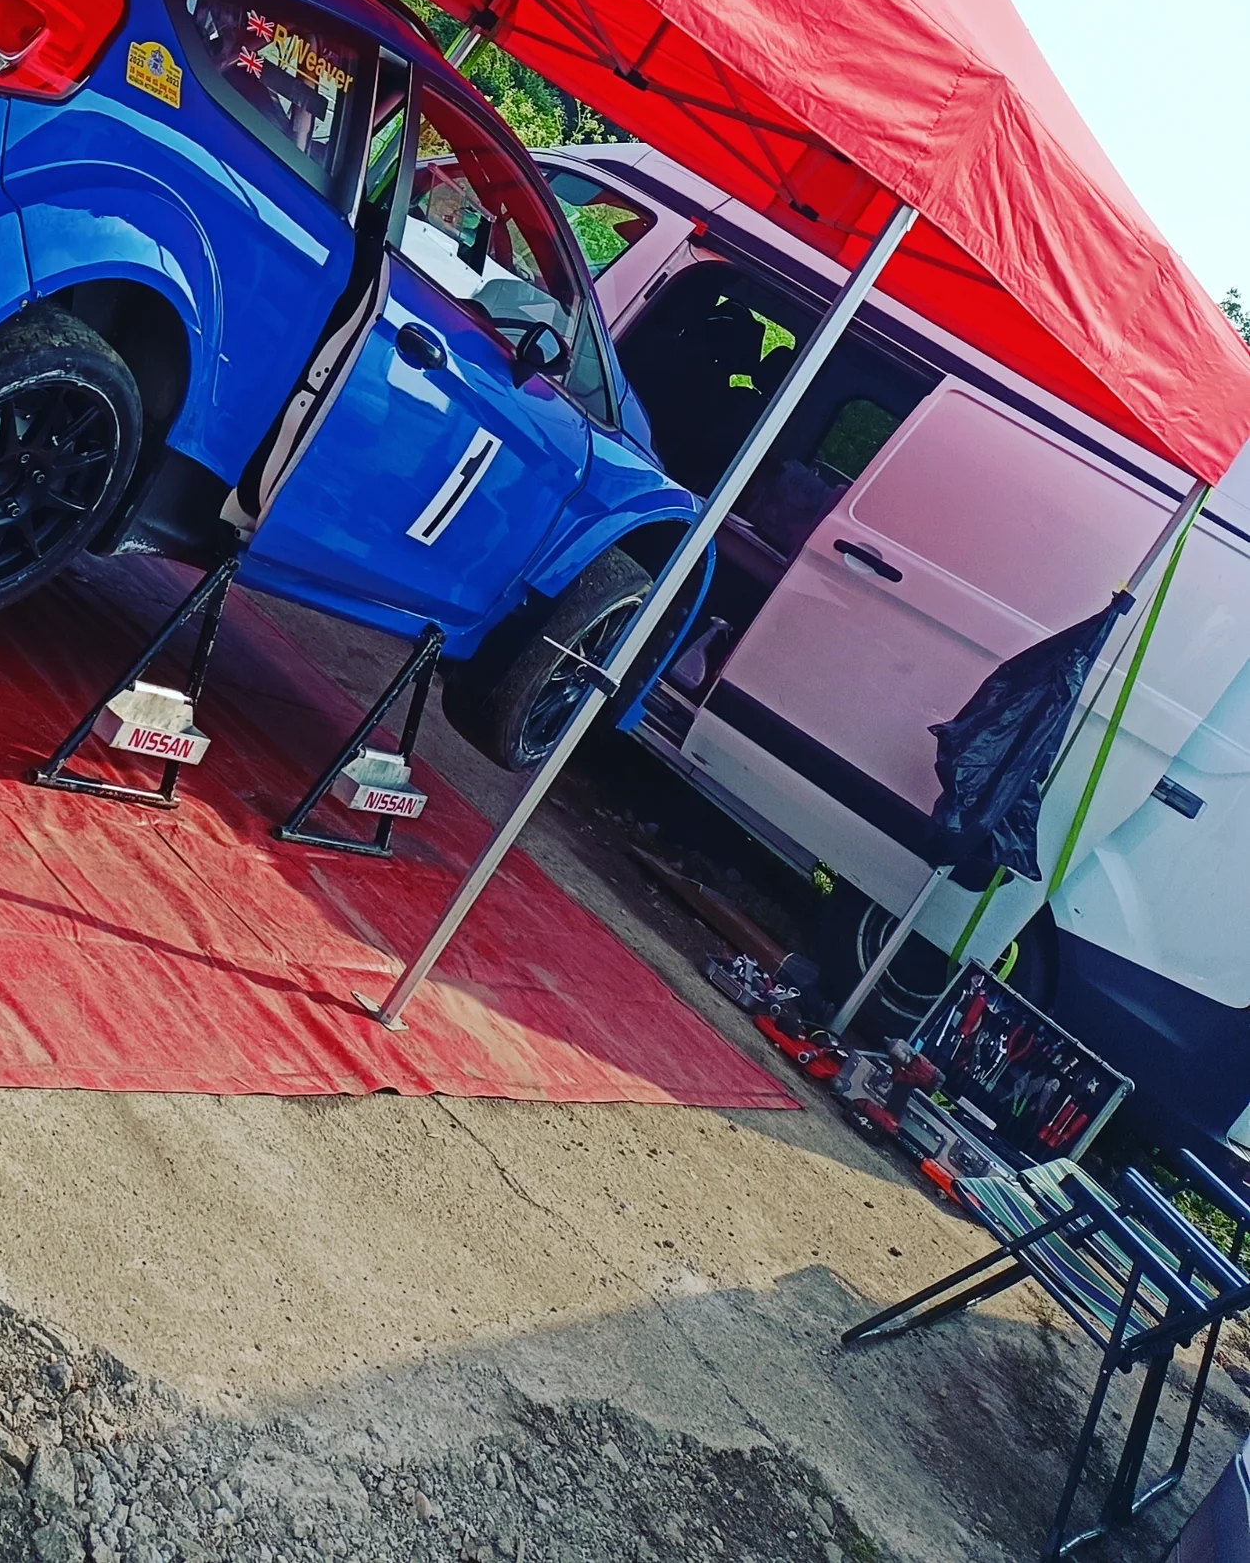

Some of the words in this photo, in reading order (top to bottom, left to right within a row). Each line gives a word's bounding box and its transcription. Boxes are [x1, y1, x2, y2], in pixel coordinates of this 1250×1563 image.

[129, 54, 144, 68] 2023
[290, 34, 354, 93] Weaver
[166, 74, 180, 88] 2023
[420, 438, 494, 539] 1
[127, 728, 195, 759] NISSAN
[363, 791, 418, 815] NISSAN
